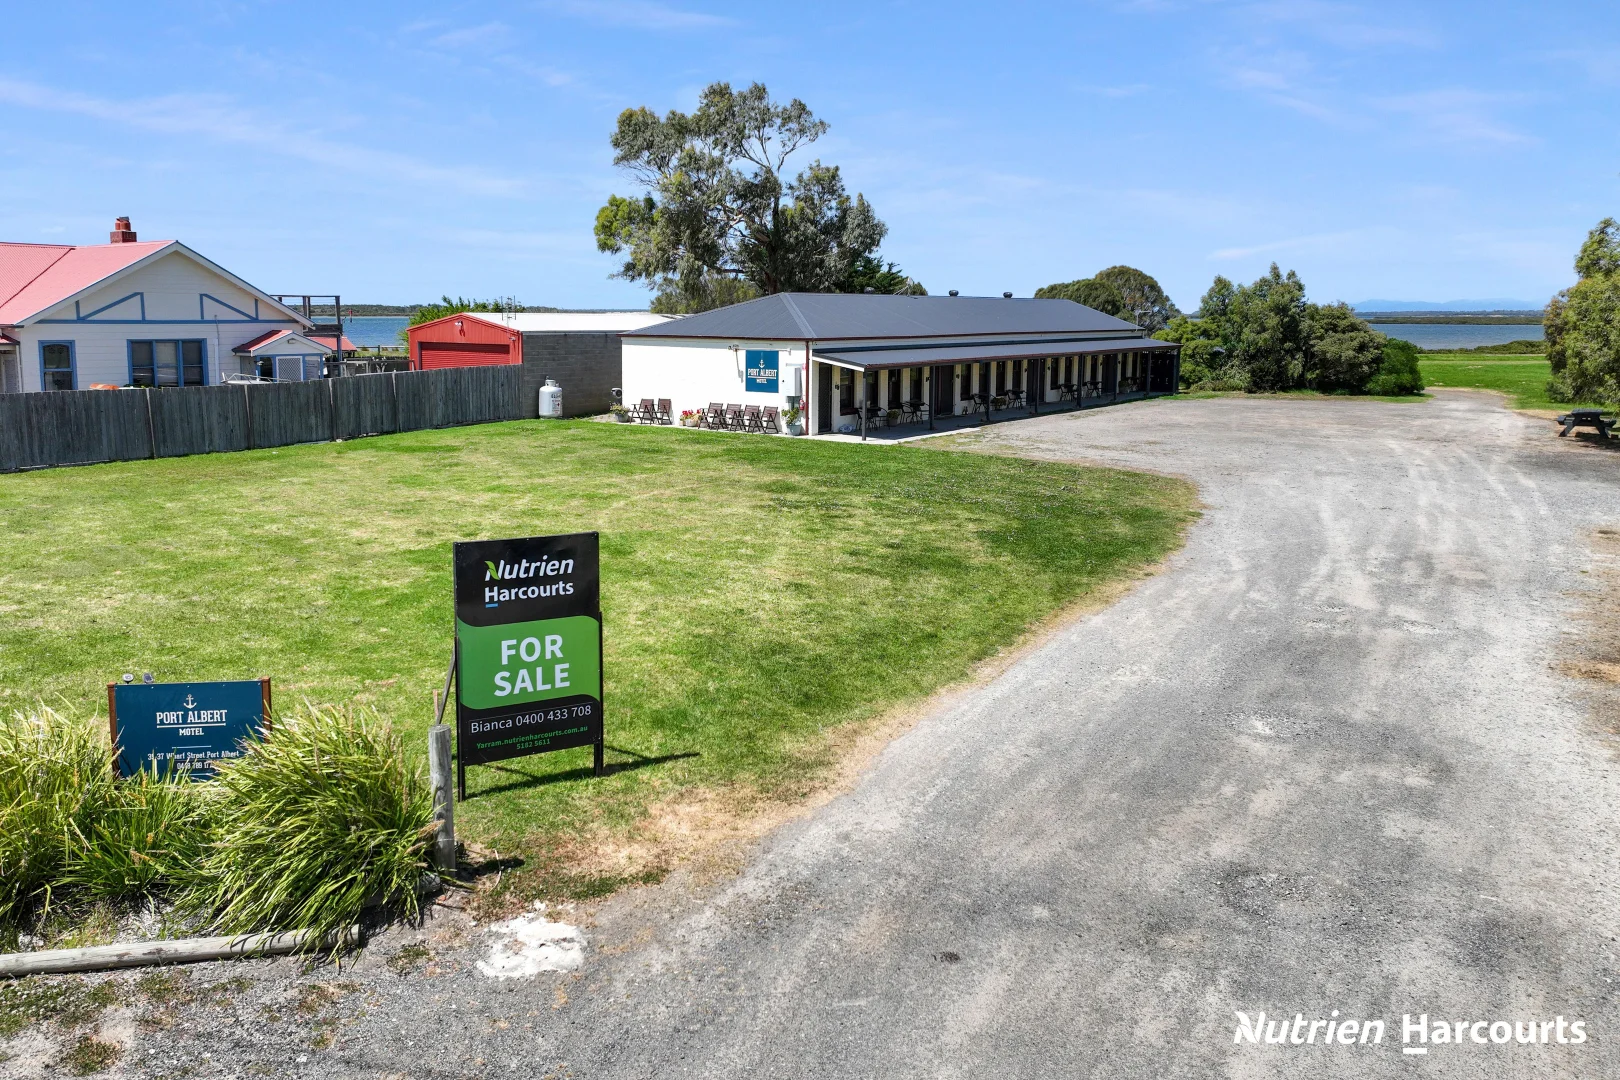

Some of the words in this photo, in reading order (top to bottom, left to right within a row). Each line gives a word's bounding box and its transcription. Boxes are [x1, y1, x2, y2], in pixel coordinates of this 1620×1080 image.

[747, 368, 759, 376] PORT
[760, 369, 777, 377] ALBERT
[484, 555, 574, 582] Nutrien
[484, 580, 574, 604] Harcourts
[501, 634, 564, 666] FOR
[493, 663, 571, 697] SALE
[156, 711, 184, 724] PORT
[187, 709, 228, 723] ALBERT
[470, 717, 513, 734] Bianca
[515, 712, 545, 727] 0400
[547, 708, 569, 721] 433
[571, 704, 592, 717] 708
[179, 727, 205, 736] MOTEL
[476, 725, 589, 750] Yarram.nutrienharcourts.com.au
[186, 751, 205, 759] Street
[206, 750, 220, 759] Port
[221, 750, 240, 758] Albert
[516, 741, 533, 750] 5182
[534, 738, 551, 747] 5611
